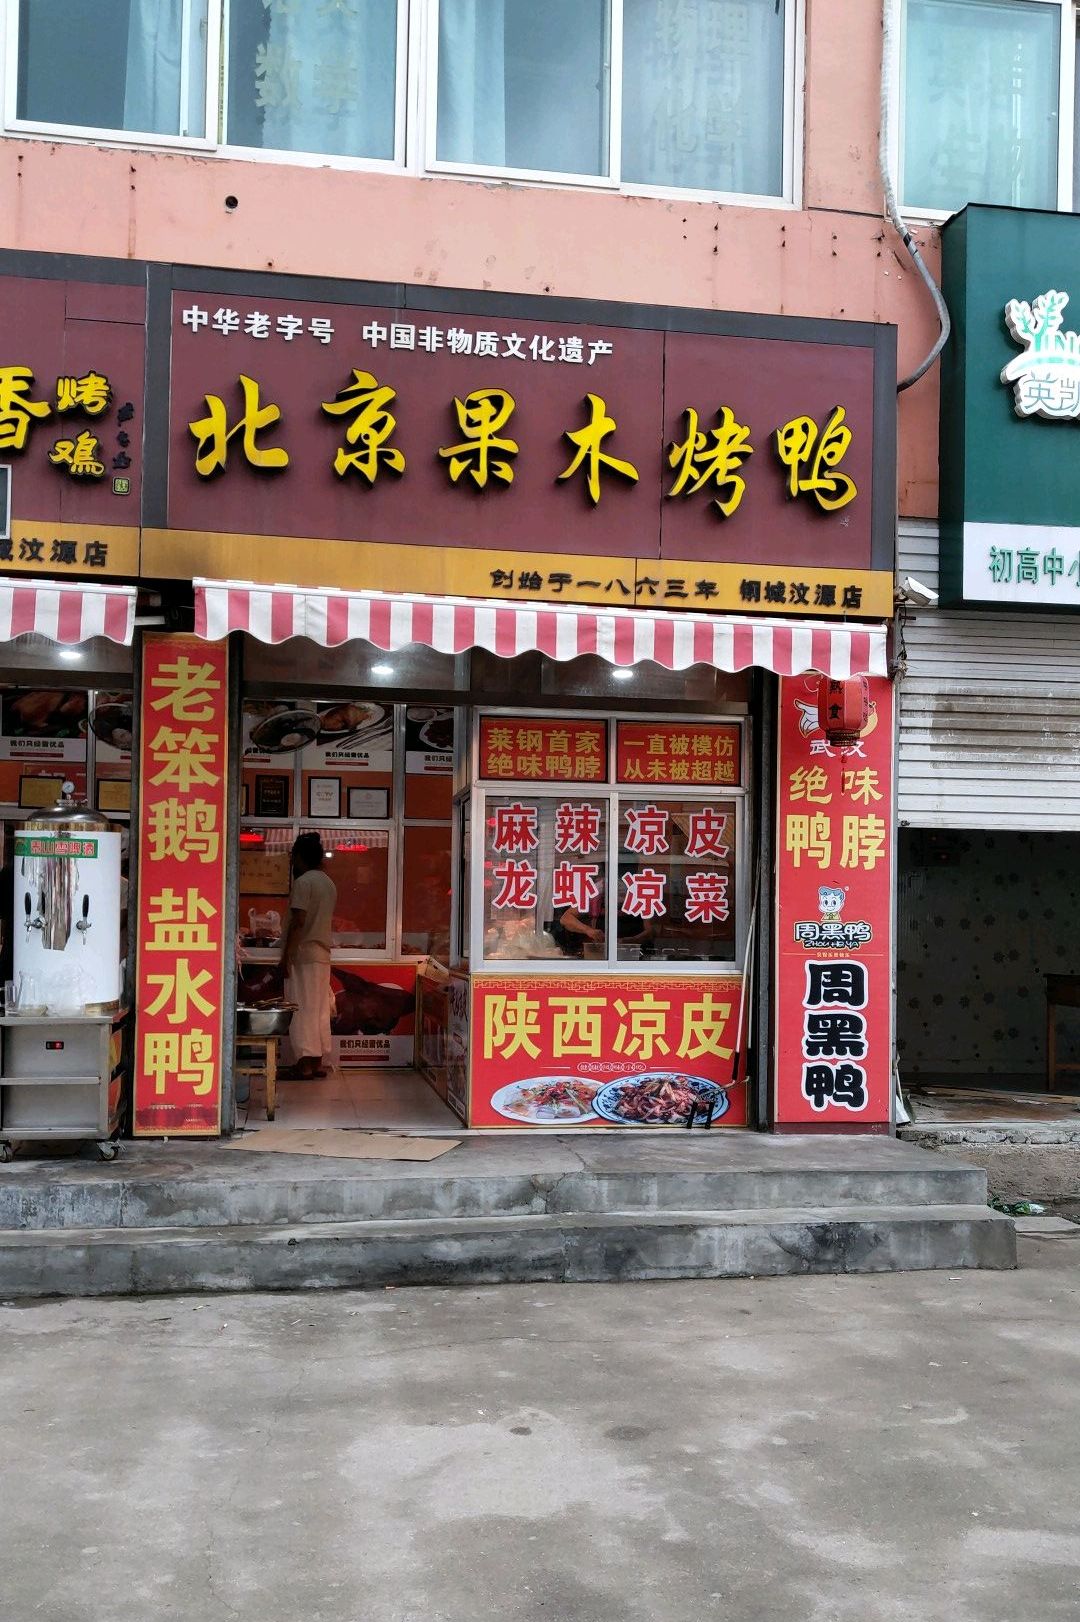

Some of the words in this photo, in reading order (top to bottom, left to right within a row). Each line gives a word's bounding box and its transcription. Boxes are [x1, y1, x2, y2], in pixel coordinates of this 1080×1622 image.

[182, 305, 335, 344] 中华老字号
[362, 321, 613, 365] 中国非物质文化遗产
[187, 368, 859, 518] 北京果木烤鸭
[489, 568, 720, 600] 创始于一八六三年
[739, 578, 863, 609] 钢城汶源店
[148, 656, 221, 863] 老笨鹅
[487, 728, 600, 754] 莱钢首家
[487, 753, 601, 779] 绝味鸭脖
[623, 734, 736, 756] 一直被模仿
[623, 758, 735, 782] 从未被超越
[789, 765, 884, 805] 绝味
[494, 802, 601, 854] 麻辣
[624, 805, 729, 858] 凉皮
[785, 811, 886, 870] 鸭脖
[493, 859, 598, 913] 龙虾
[622, 868, 729, 923] 凉菜
[794, 921, 873, 941] 周黑鸭
[143, 887, 218, 1096] 盐水鸭
[483, 992, 734, 1060] 陕西凉皮
[803, 961, 868, 1111] 周黑鸭
